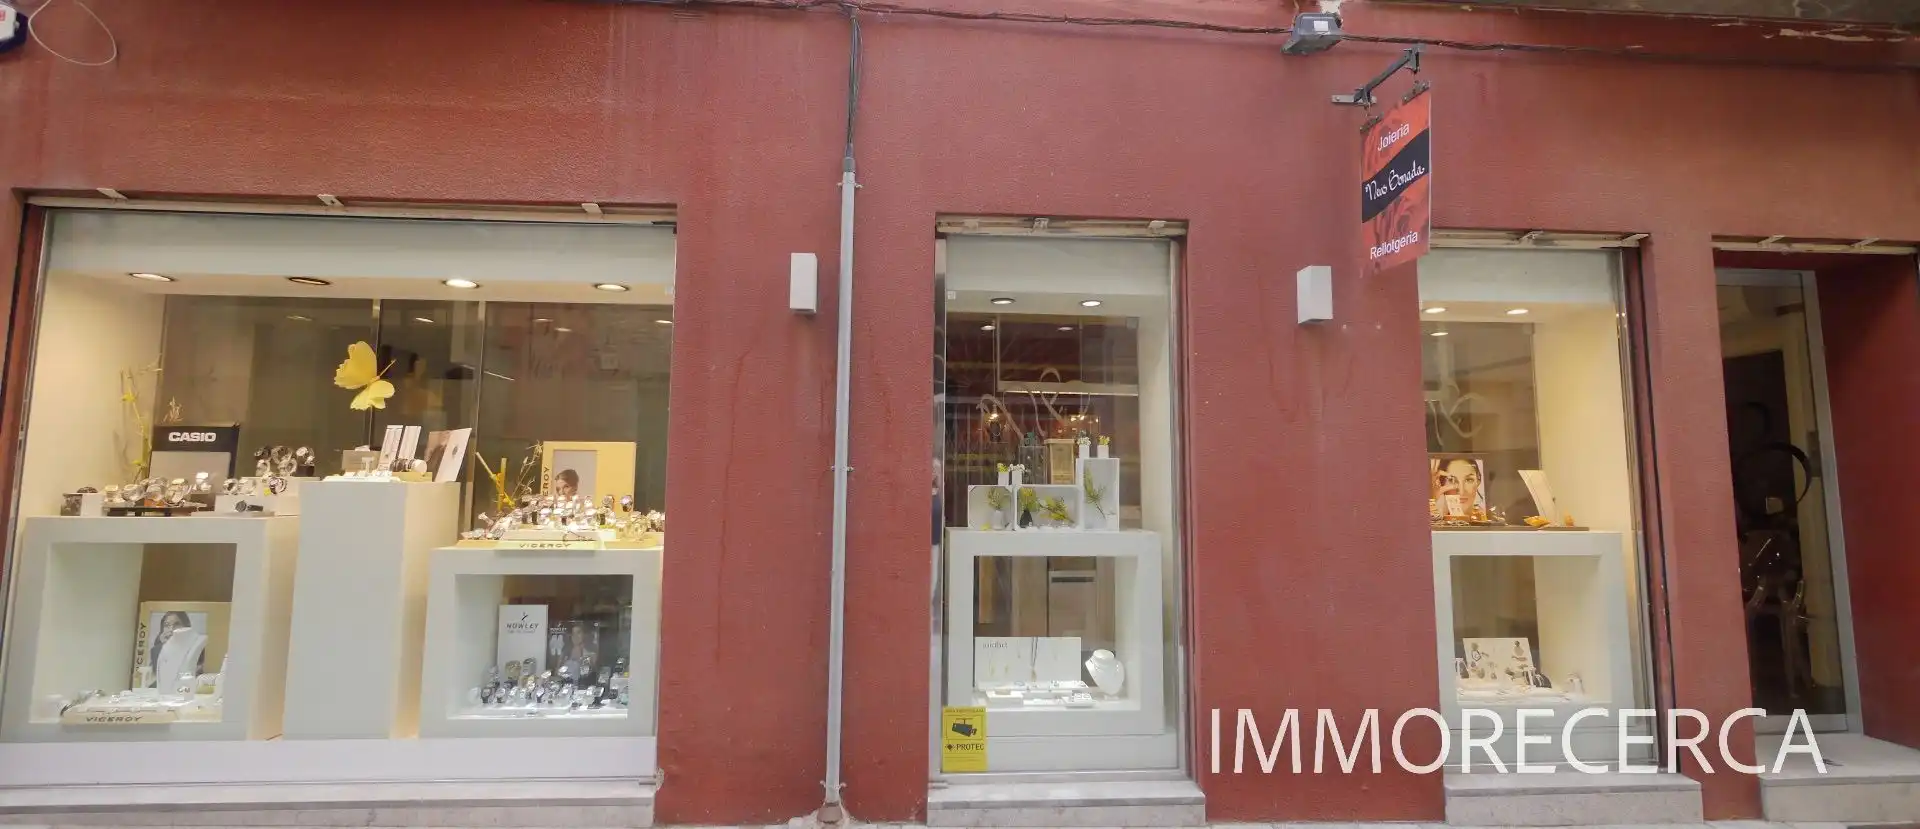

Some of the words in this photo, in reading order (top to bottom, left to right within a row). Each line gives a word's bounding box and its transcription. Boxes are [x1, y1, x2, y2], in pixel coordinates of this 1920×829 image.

[1377, 122, 1410, 151] Joieria
[1370, 230, 1418, 260] Rellotgeria
[168, 431, 217, 442] CASIO
[135, 622, 147, 672] CEROY
